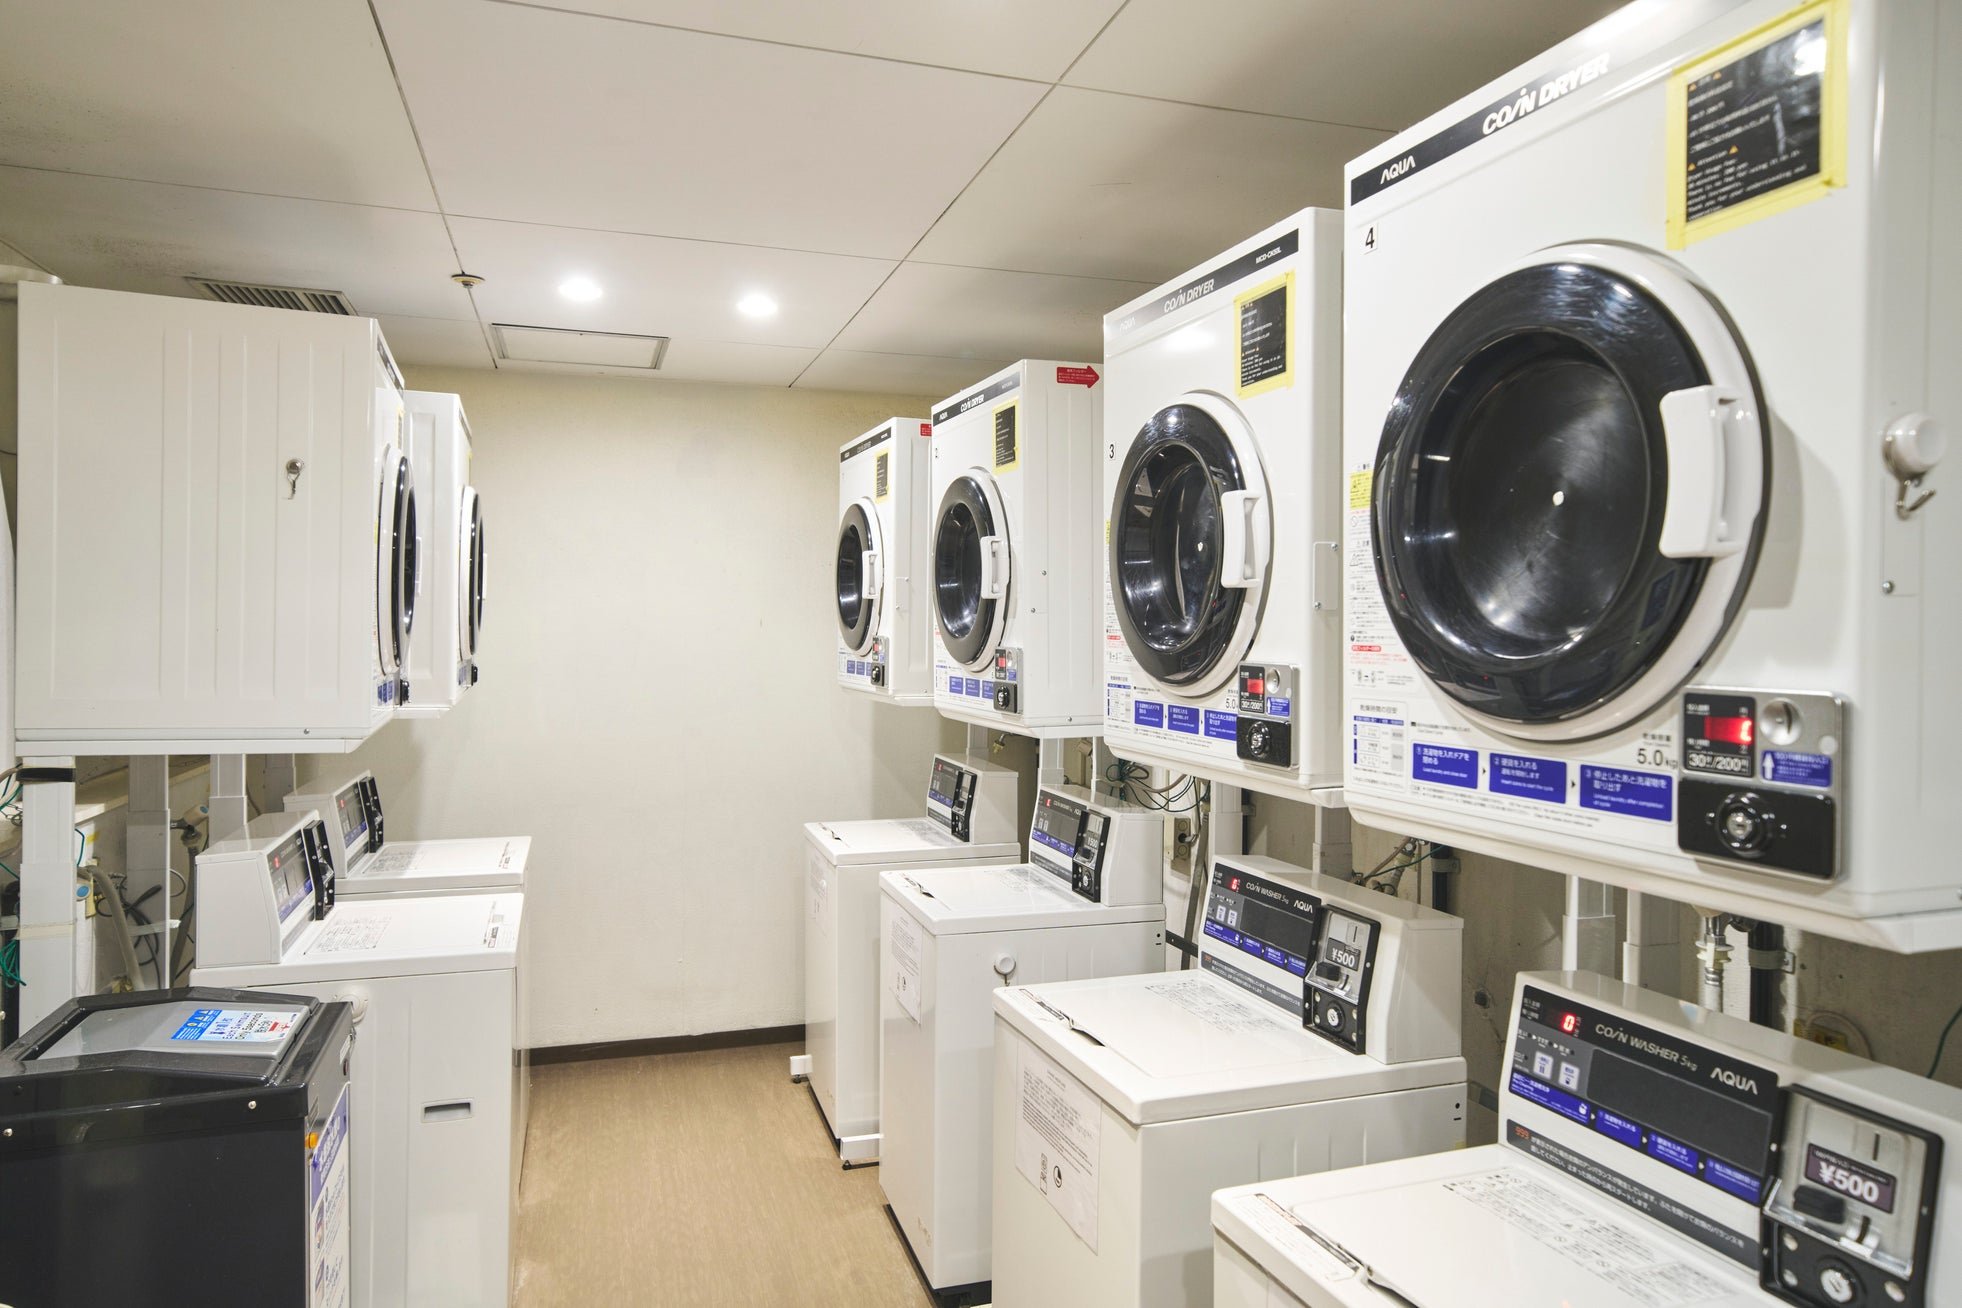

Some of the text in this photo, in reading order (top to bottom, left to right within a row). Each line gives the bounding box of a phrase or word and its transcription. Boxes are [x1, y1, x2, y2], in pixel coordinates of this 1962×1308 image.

[1380, 155, 1416, 184] AQUA
[1538, 53, 1611, 107] DRYER
[1365, 227, 1375, 249] 4
[1187, 279, 1215, 302] DRYER
[1109, 444, 1115, 459] 3
[1260, 888, 1282, 901] WASHER
[1293, 900, 1314, 914] AQUA
[1331, 947, 1356, 968] ¥500
[1563, 1014, 1576, 1032] 0
[1629, 1036, 1680, 1063] WASHER
[1710, 1066, 1758, 1095] AQUA
[1818, 1161, 1879, 1203] ¥500
